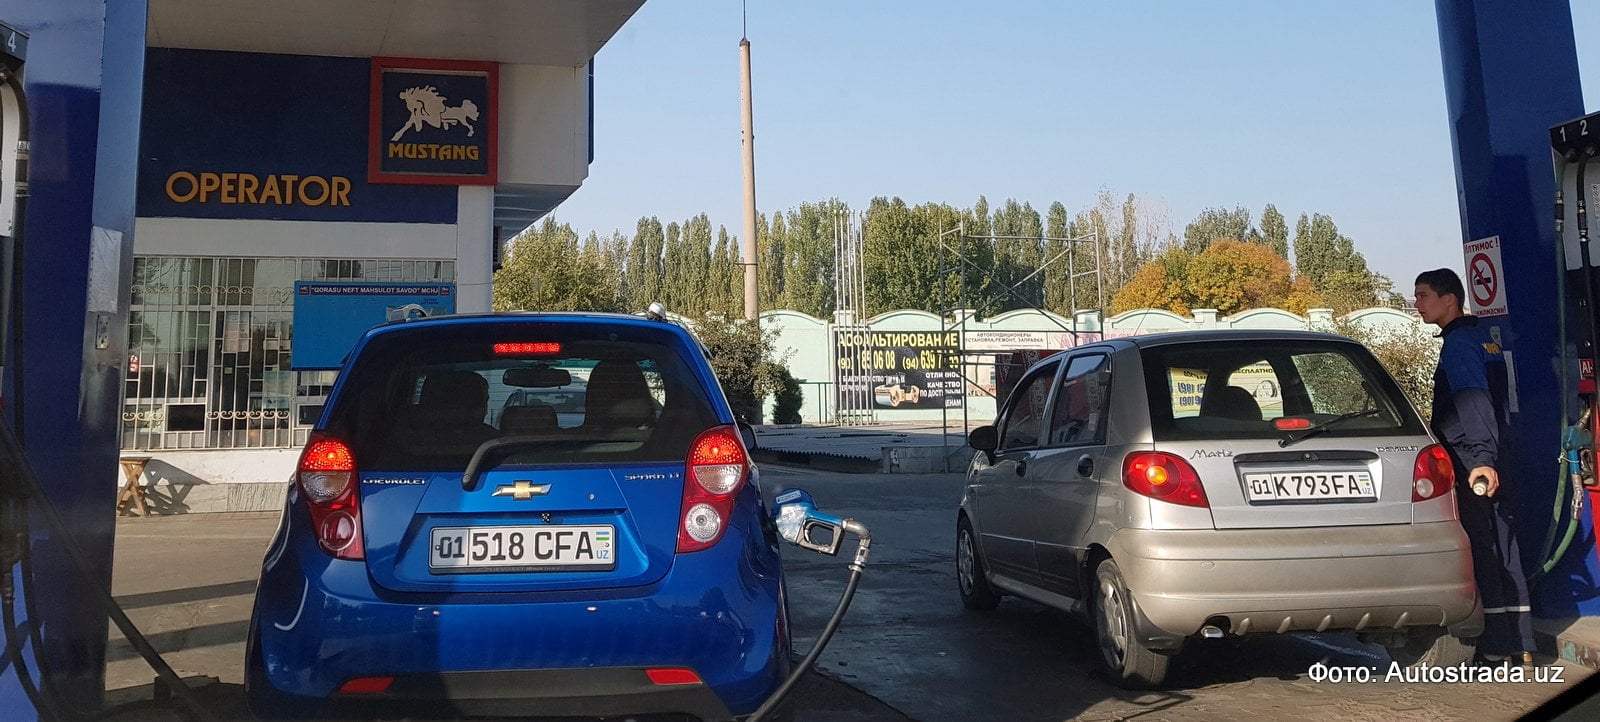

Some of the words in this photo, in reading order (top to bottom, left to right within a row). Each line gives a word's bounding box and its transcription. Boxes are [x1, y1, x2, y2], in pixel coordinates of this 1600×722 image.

[8, 31, 16, 53] 4
[1559, 126, 1566, 142] 1
[1580, 119, 1589, 136] 2
[388, 142, 480, 161] MUSTANG
[165, 170, 352, 207] OPERATOR
[902, 356, 919, 370] (94)
[1189, 449, 1234, 460] Matiz
[1253, 479, 1273, 495] 01
[439, 536, 465, 559] 01
[472, 531, 525, 561] 518
[535, 531, 594, 561] CFA
[596, 550, 609, 560] UZ
